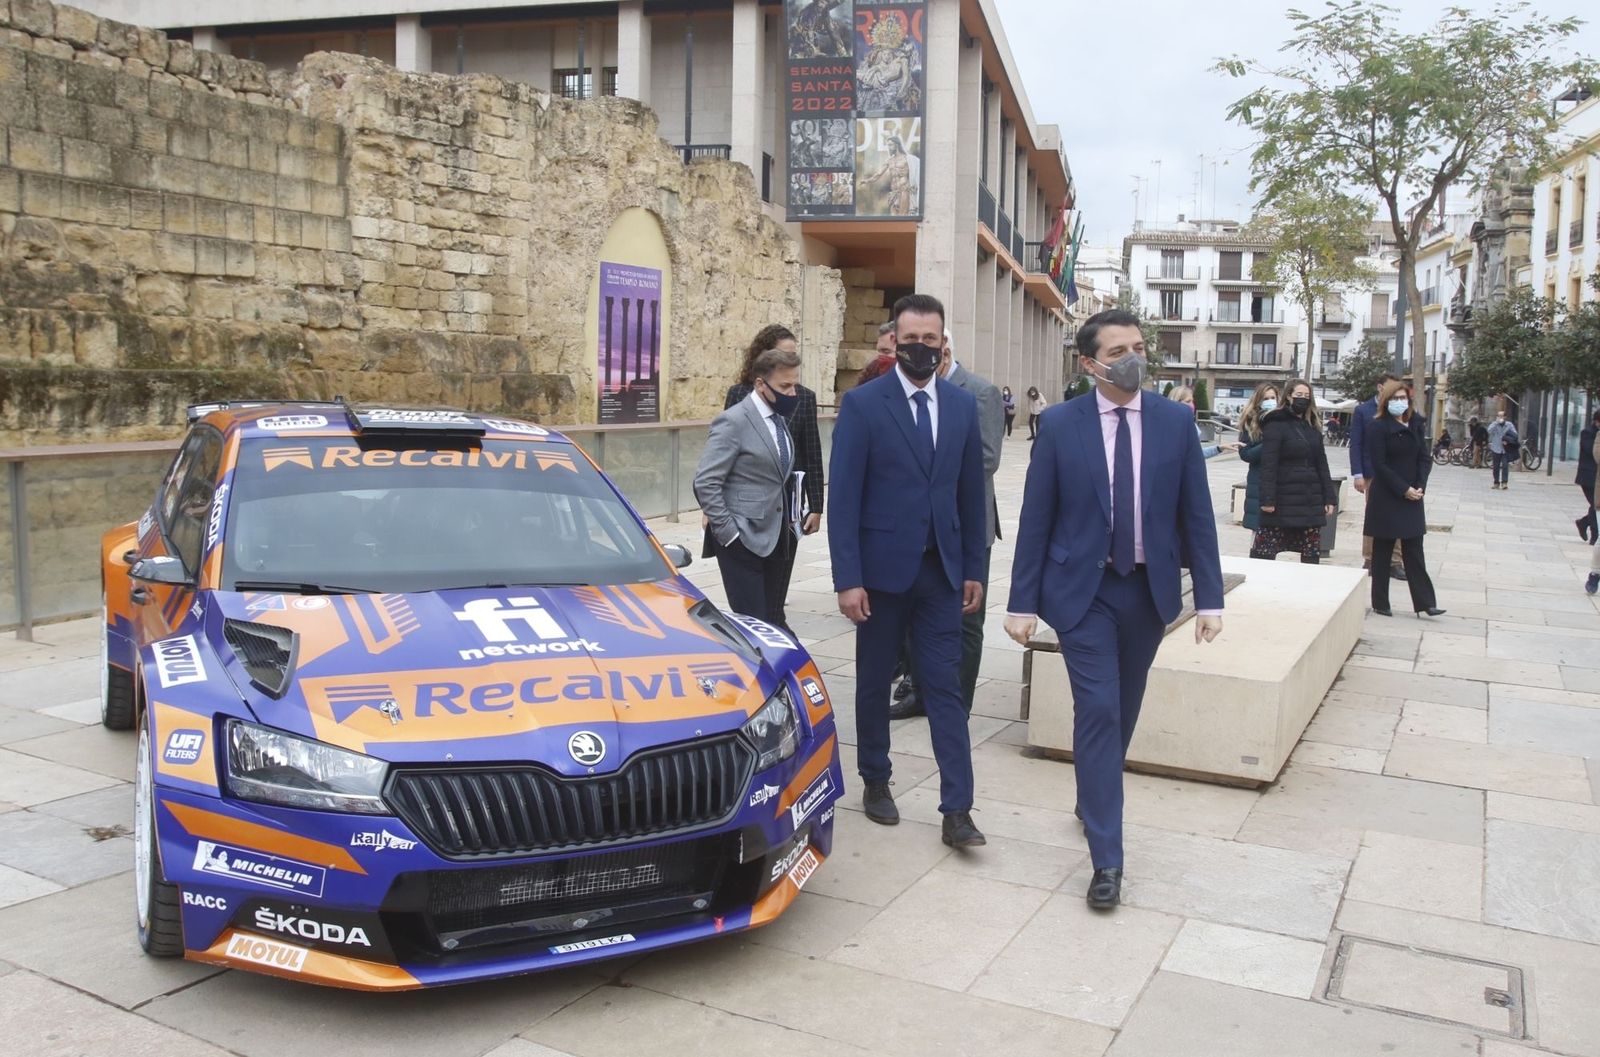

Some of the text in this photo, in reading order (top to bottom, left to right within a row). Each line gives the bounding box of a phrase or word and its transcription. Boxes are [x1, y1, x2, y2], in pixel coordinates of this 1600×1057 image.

[790, 65, 853, 76] SEMANA
[791, 80, 853, 92] SANTA
[792, 96, 852, 111] 2022
[321, 446, 527, 470] Recalvi
[207, 483, 230, 550] ŠKODA
[453, 596, 568, 642] fi
[158, 638, 199, 682] MOTUL
[458, 638, 606, 661] network
[415, 667, 686, 717] Recalvi
[169, 733, 203, 750] UFI
[165, 749, 198, 761] FILTERS
[232, 858, 313, 887] MICHELIN
[792, 853, 817, 886] MOTUL
[182, 891, 227, 911] RACC
[254, 906, 372, 947] ŠKODA
[230, 936, 301, 969] MOTUL
